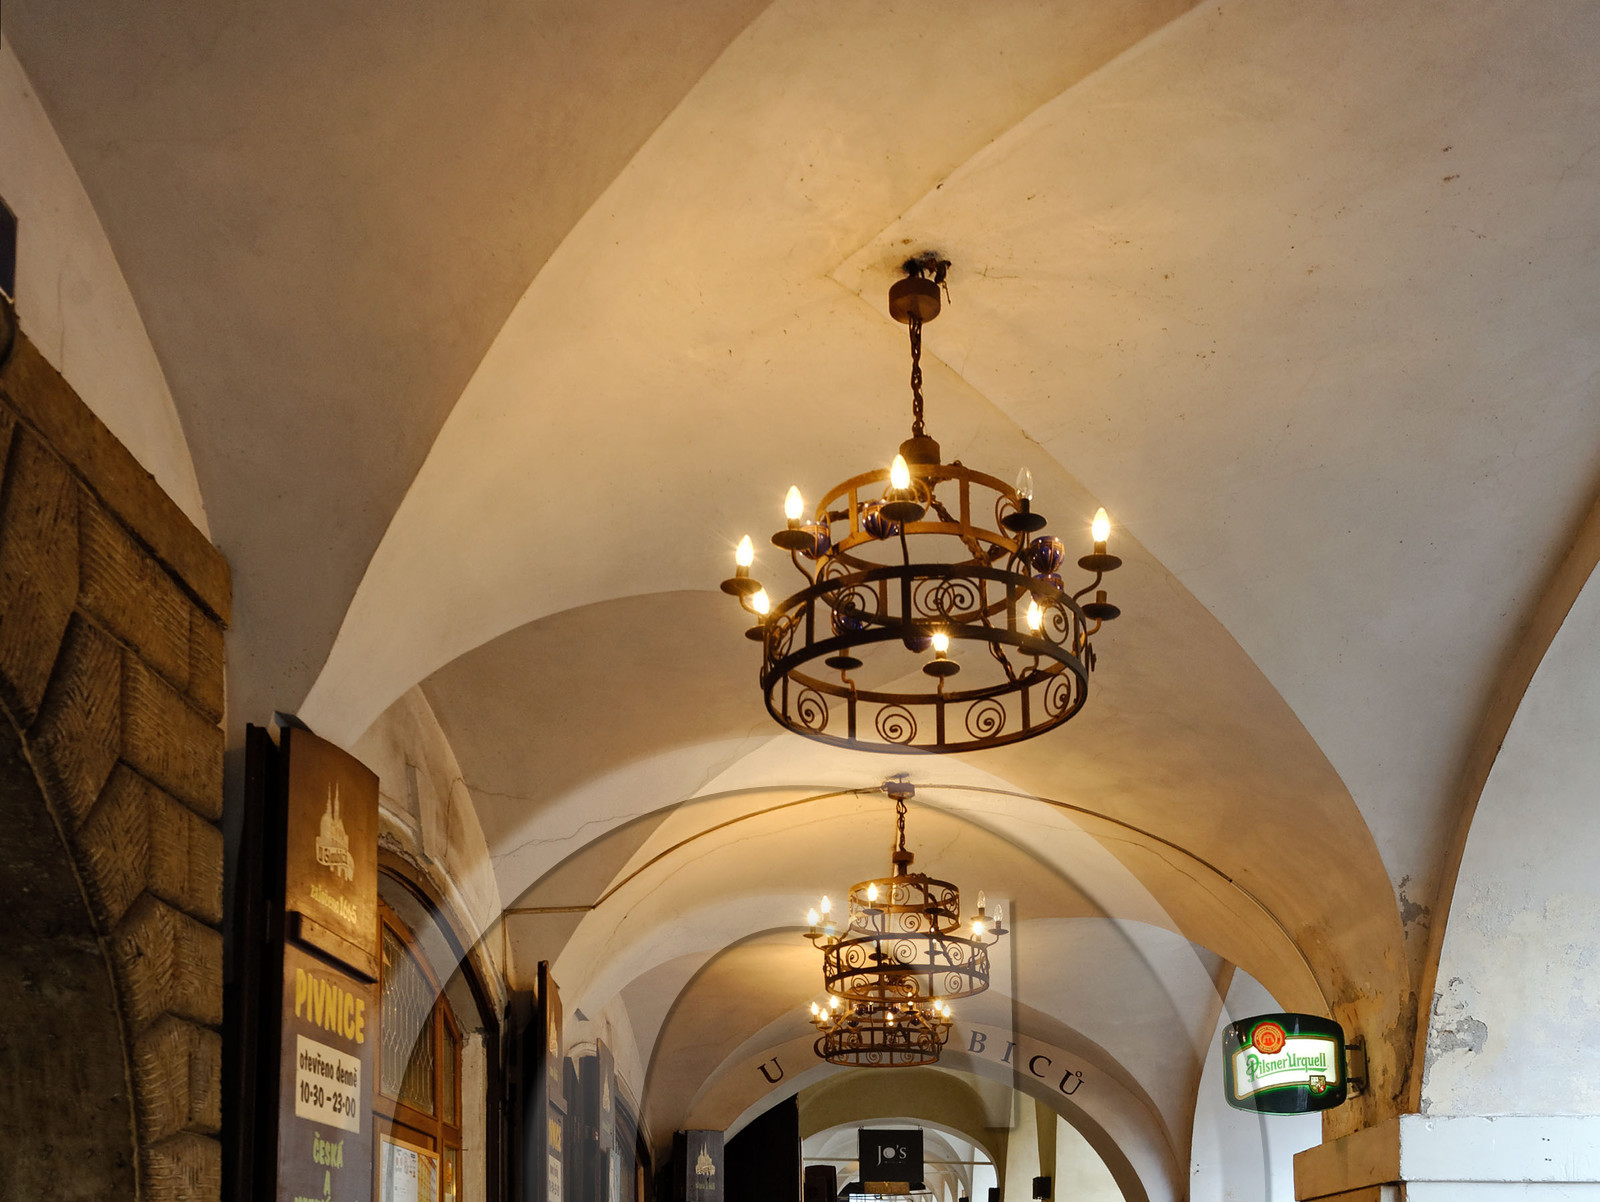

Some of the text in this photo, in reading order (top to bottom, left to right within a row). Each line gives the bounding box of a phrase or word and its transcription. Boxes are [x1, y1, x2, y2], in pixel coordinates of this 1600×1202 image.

[295, 968, 365, 1044] PIVNICE
[757, 1056, 785, 1084] U
[1246, 1052, 1326, 1083] Pilsner Urquell
[312, 1131, 344, 1169] ČESKÁ
[323, 1170, 331, 1196] A
